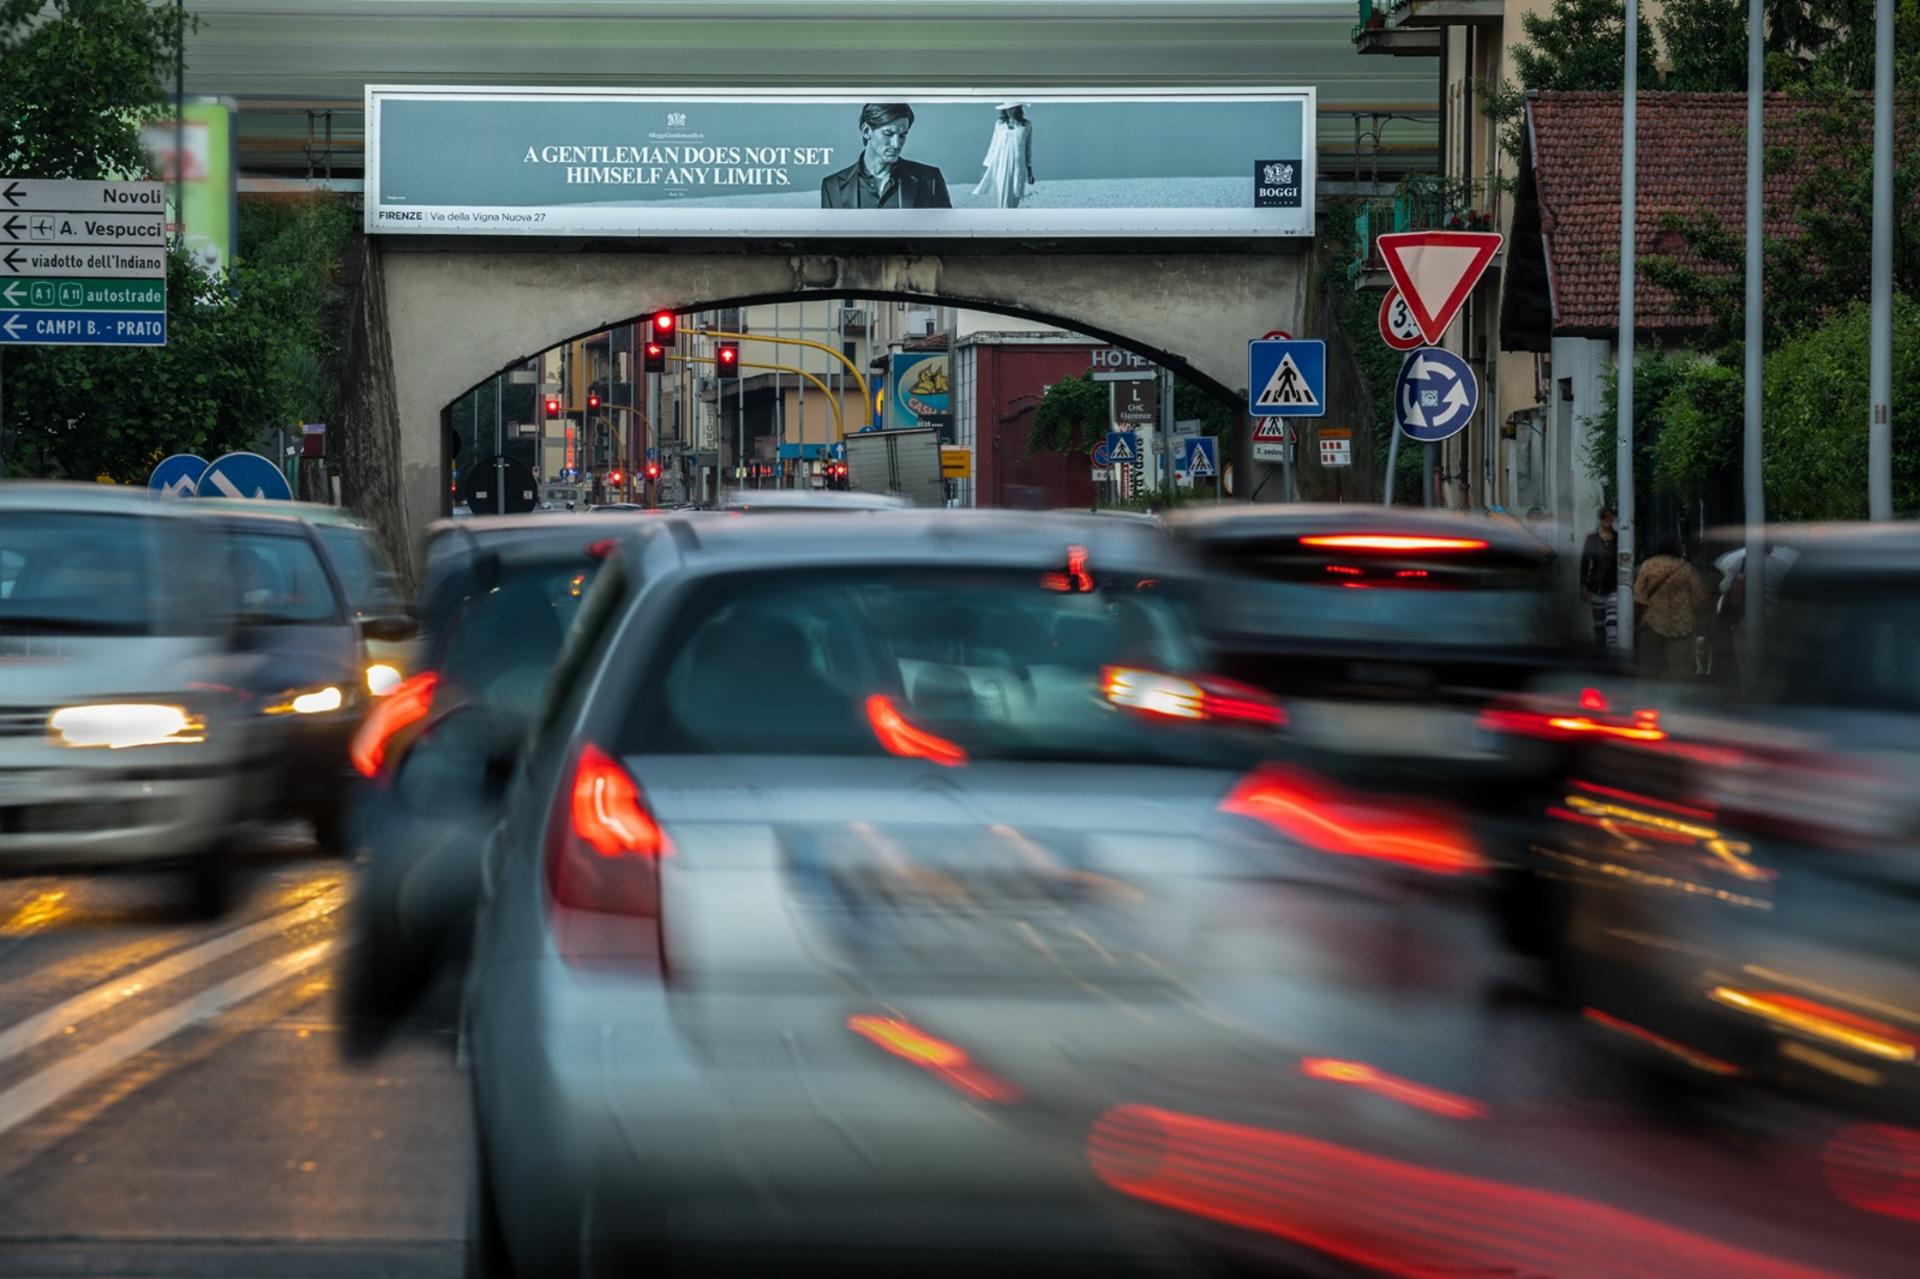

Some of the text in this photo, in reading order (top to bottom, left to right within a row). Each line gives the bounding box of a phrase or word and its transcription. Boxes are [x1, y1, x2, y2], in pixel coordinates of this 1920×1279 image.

[524, 145, 834, 165] A GENTLEMAN DOES NOT SET
[566, 166, 790, 185] HIMSELF ANY LIMITS.
[103, 188, 161, 204] Novoli
[1259, 187, 1297, 197] BOGGI
[378, 211, 547, 223] FIRENZE Via della Vigna Nuova 27
[60, 221, 161, 239] A. Vespucci
[31, 253, 161, 270] viadotto dell'Indiano
[87, 288, 161, 303] autostrade
[36, 319, 81, 335] CAMPI
[87, 321, 100, 335] B.
[117, 321, 161, 336] PRATO
